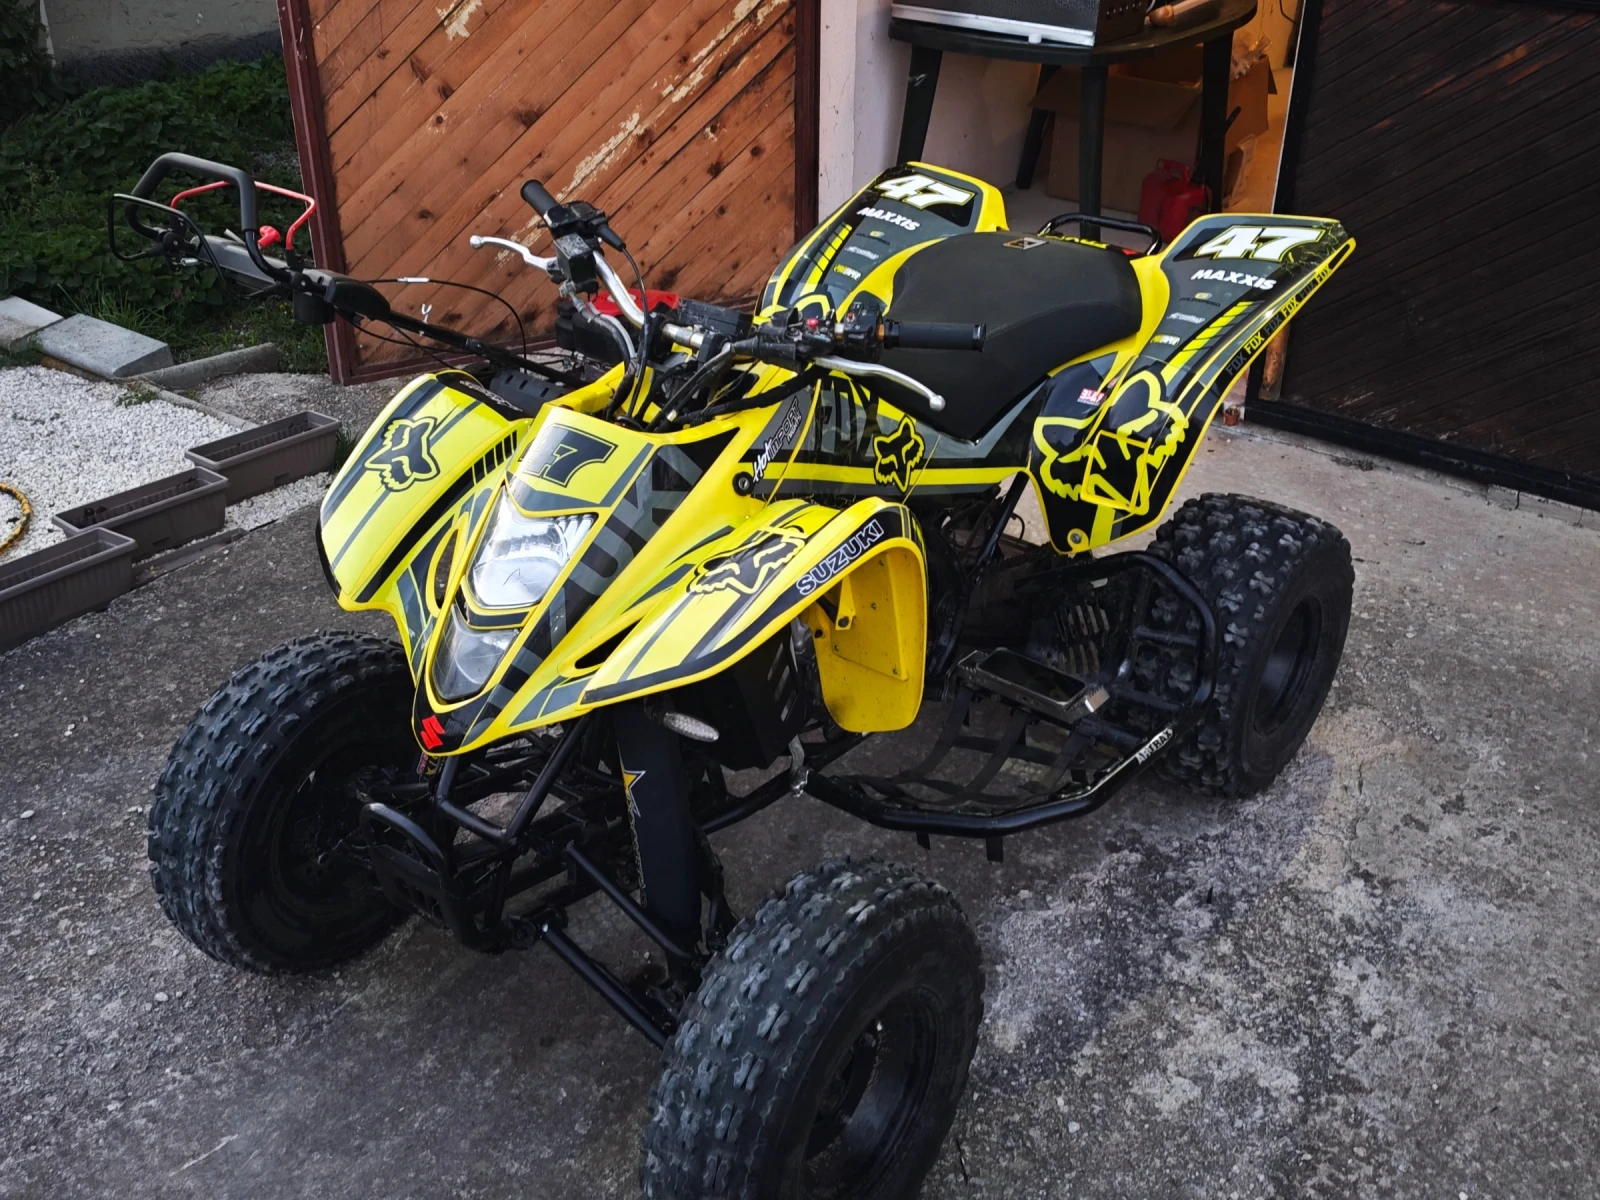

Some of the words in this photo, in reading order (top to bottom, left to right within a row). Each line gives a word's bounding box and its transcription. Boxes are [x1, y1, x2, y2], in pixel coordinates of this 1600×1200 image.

[874, 174, 976, 211] 47
[856, 207, 920, 231] MAXXIS
[1193, 225, 1326, 263] 47
[1190, 269, 1277, 290] MAXXIS
[1227, 352, 1248, 376] FOX
[1243, 331, 1265, 355] FOX
[1264, 314, 1283, 335] FOX
[1281, 297, 1300, 317] FOX
[1315, 264, 1333, 284] FOX
[796, 518, 885, 596] SUZUKI
